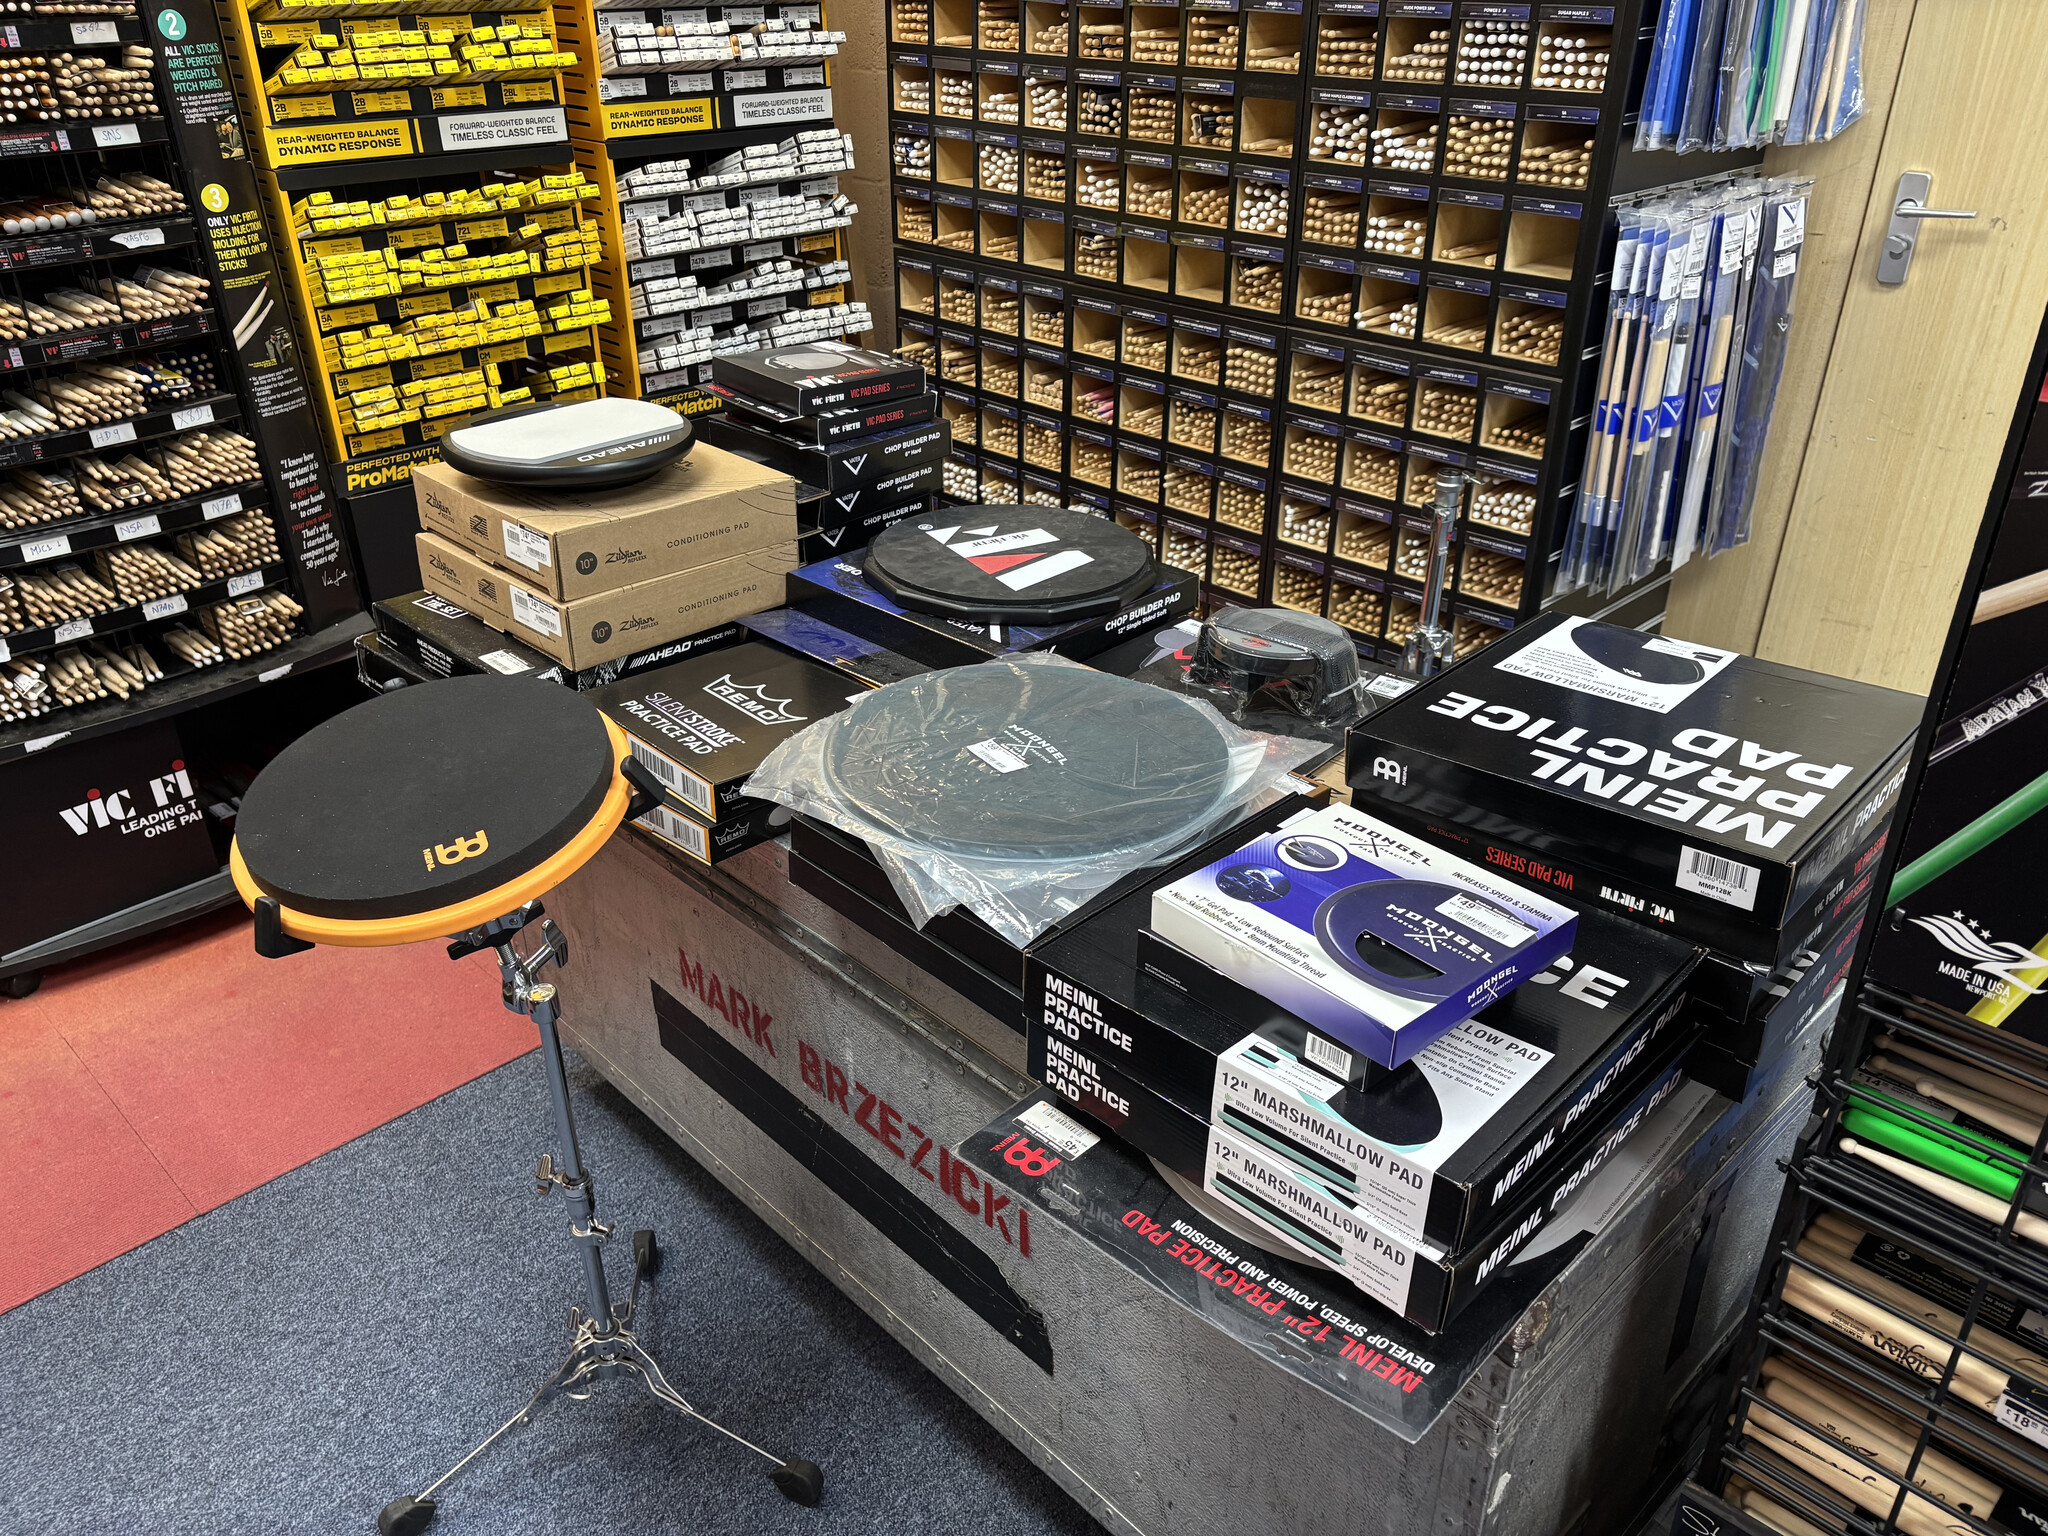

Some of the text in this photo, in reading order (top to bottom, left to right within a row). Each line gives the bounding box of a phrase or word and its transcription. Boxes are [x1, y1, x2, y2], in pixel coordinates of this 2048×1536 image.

[165, 12, 180, 36] 2
[260, 29, 273, 40] 5B
[164, 42, 219, 57] ALL VIC STICKS
[168, 55, 223, 69] ARE PERFECTLY
[170, 67, 217, 81] WEIGHTED &
[173, 79, 223, 93] PITCH PAIRED
[503, 88, 518, 97] 2BL
[274, 104, 287, 113] 2B
[450, 116, 556, 131] FORWARD-WEIGHTED BALANCE
[451, 126, 558, 142] TIMELESS CLASSIC FEEL
[277, 128, 399, 145] REAR-WEIGHTED BALANCE
[279, 137, 402, 156] DYNAMIC RESPONSE
[209, 187, 223, 208] 3
[684, 200, 695, 208] 747
[207, 210, 258, 228] ONLY VIC FIRTH
[210, 221, 262, 239] USES INJECTION
[456, 226, 471, 235] 721
[213, 233, 259, 249] MOLDING FOR
[215, 242, 268, 261] THEIR NYLON TIP
[389, 235, 404, 245] 7AL
[218, 259, 248, 272] STICKS!
[321, 313, 333, 323] 5A
[479, 351, 491, 361] CM
[412, 364, 427, 373] 5BL
[850, 389, 860, 399] VIC
[860, 387, 871, 397] PAD
[872, 383, 890, 395] SERIES
[352, 440, 362, 449] 2B
[884, 432, 940, 454] CHOP BUILDER PAD
[346, 446, 440, 473] PERFECTED WITH
[290, 490, 325, 511] in your hands
[300, 504, 322, 518] to create
[667, 521, 750, 549] CONDITIONING PAD
[580, 548, 643, 570] 10" Zildjian
[628, 554, 647, 563] REFLEXX
[678, 584, 757, 614] CONDITIONING PAD
[1105, 592, 1181, 632] CHOP BUILDER PAD
[1126, 620, 1141, 631] Single
[1142, 614, 1156, 624] Sided
[1156, 609, 1167, 618] Soft
[646, 628, 736, 663] AHEAD PRACTICE PAD
[1504, 663, 1666, 710] 12" MARSHMALLOW PAD
[712, 684, 781, 721] REMO
[619, 700, 714, 755] PRACTICE PAD
[646, 692, 741, 747] SILENTSTROKE
[1427, 691, 1827, 819] PRACTICE
[1672, 727, 1854, 791] PAD
[1531, 748, 1797, 850] MEINL
[120, 802, 186, 835] LEADING
[144, 820, 177, 838] ONE
[1334, 817, 1432, 867] MOONGEL
[1486, 846, 1574, 890] VIC PAD SERIES
[1452, 871, 1553, 922] INCREASES SPEED & STAMINA
[1698, 881, 1732, 896] MMP12BK
[1938, 961, 2010, 998] MADE IN USA
[1046, 974, 1102, 1018] MEINL
[1044, 1009, 1080, 1042] PAD
[1045, 992, 1132, 1053] PRACTICE
[678, 947, 1030, 1258] MARK BRZEZICKI
[1492, 1126, 1556, 1206] MEINL
[1563, 1028, 1650, 1133] PRACTICE
[1652, 992, 1686, 1039] PAD
[1221, 1071, 1249, 1092] 12"
[1253, 1088, 1384, 1168] MARSHMALLOW
[1389, 1160, 1423, 1191] PAD
[1235, 1099, 1346, 1164] Ultra Low Volume For Silent Practice
[1121, 1209, 1176, 1251] PAD
[1170, 1219, 1237, 1265] PRECISION
[1166, 1237, 1286, 1318] PRACTICE
[1238, 1260, 1271, 1286] AND
[1267, 1279, 1319, 1311] POWER
[1282, 1314, 1333, 1343] 12"
[1320, 1301, 1369, 1338] SPEED,
[1338, 1334, 1424, 1394] MEINL
[1367, 1336, 1436, 1375] DEVELOP
